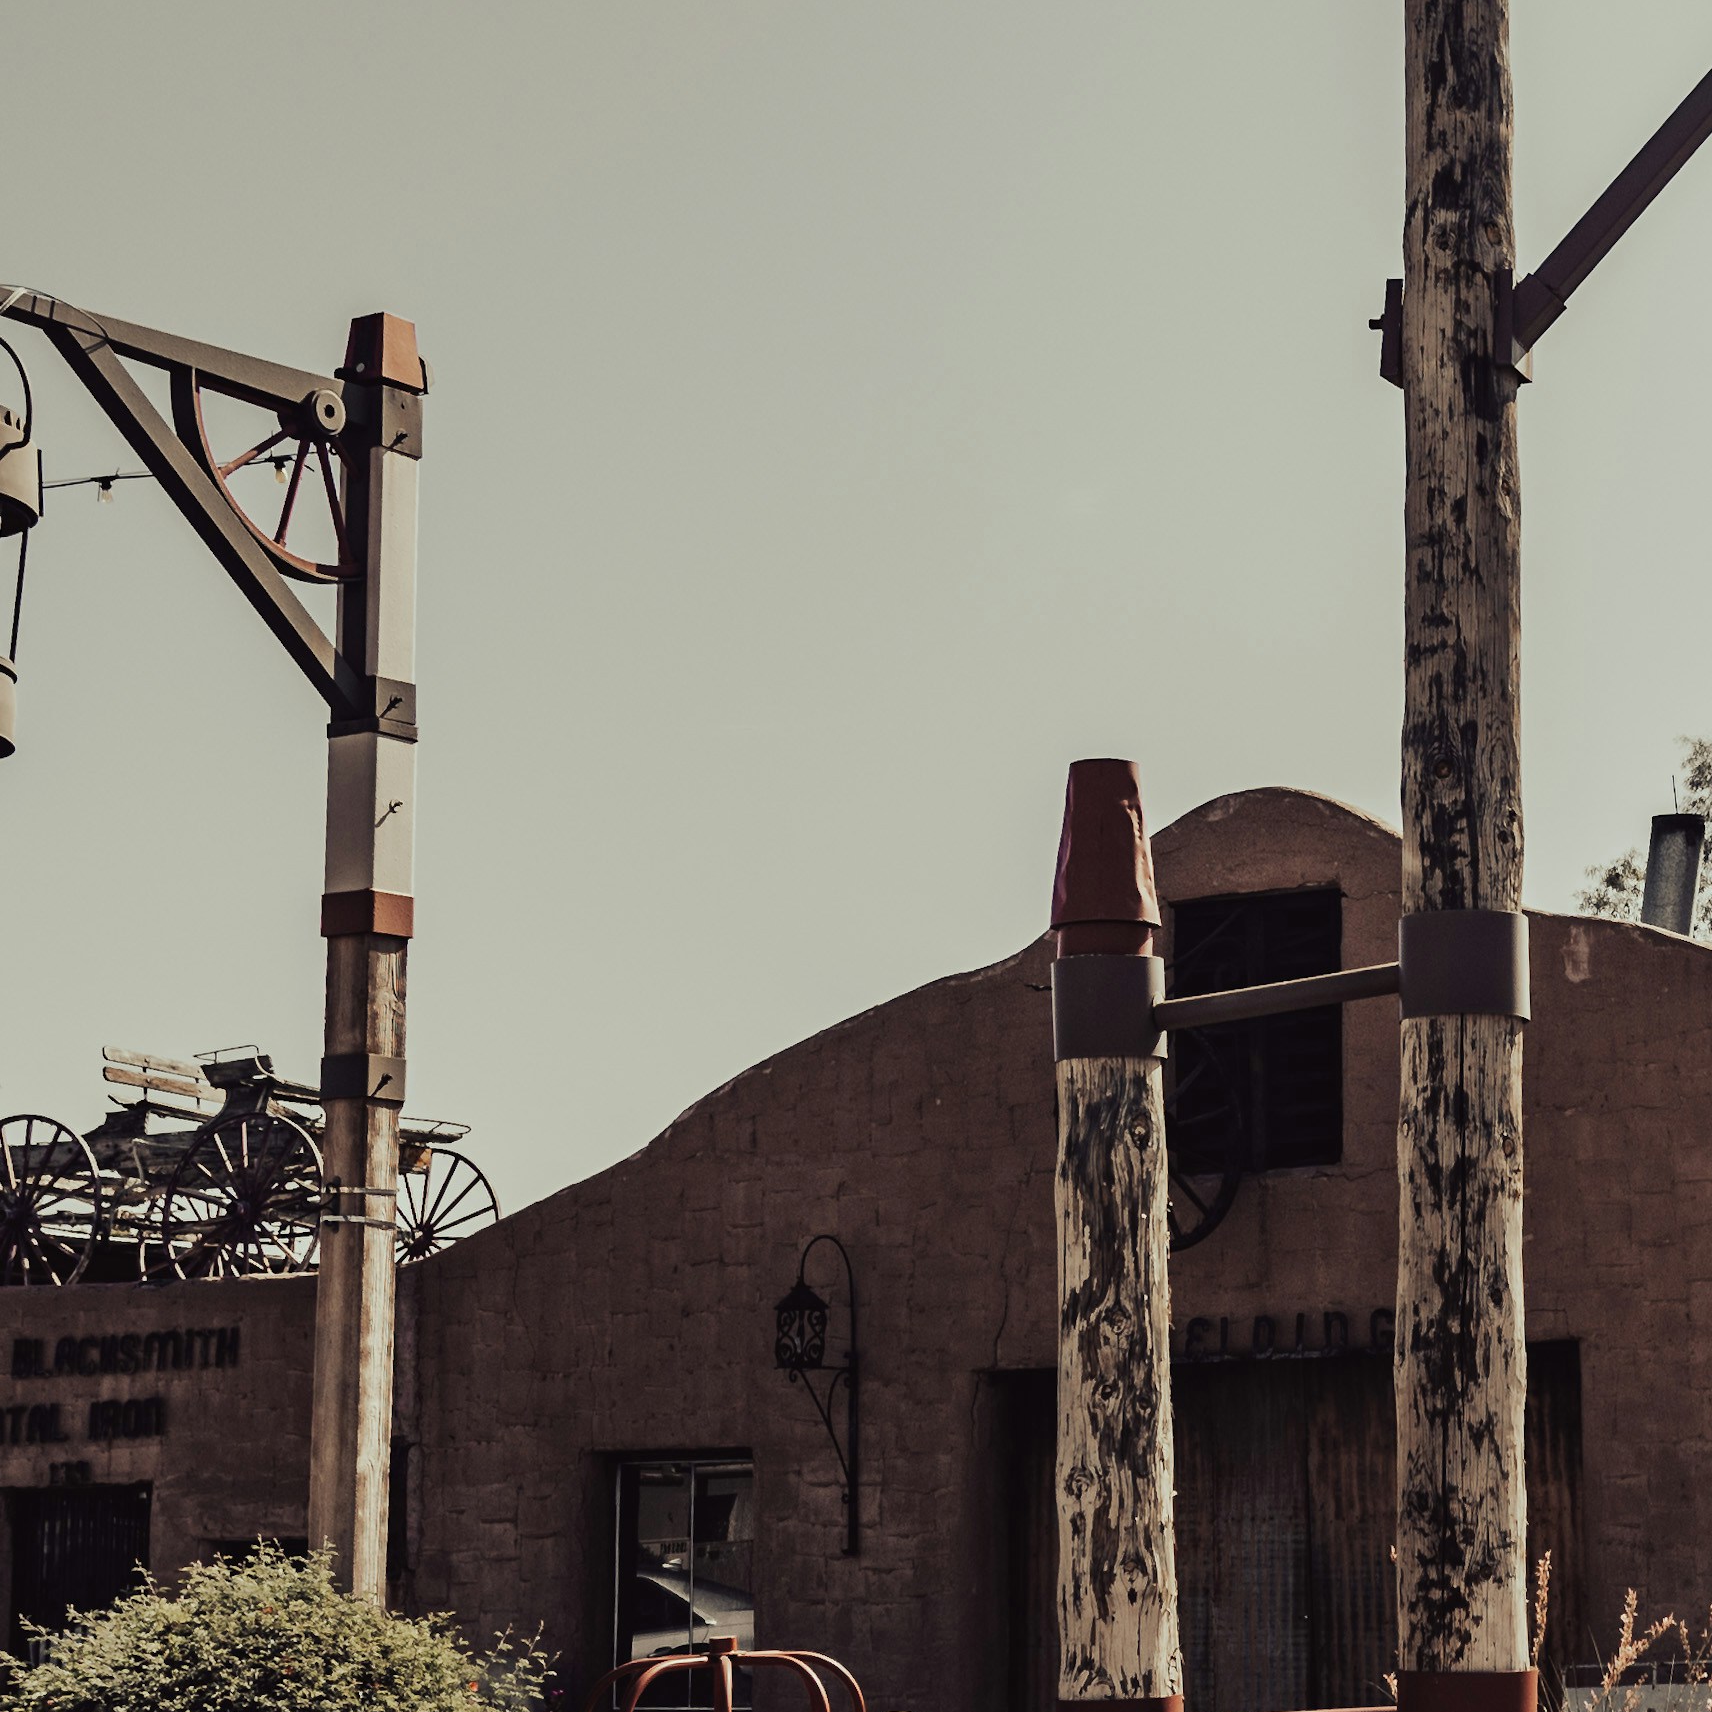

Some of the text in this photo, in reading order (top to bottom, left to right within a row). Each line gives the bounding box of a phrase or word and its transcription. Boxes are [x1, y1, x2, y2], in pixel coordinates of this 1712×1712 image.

[11, 1326, 241, 1379] BLACKSMITH
[1184, 1308, 1395, 1361] ELDING
[0, 1396, 167, 1445] TAL IRON
